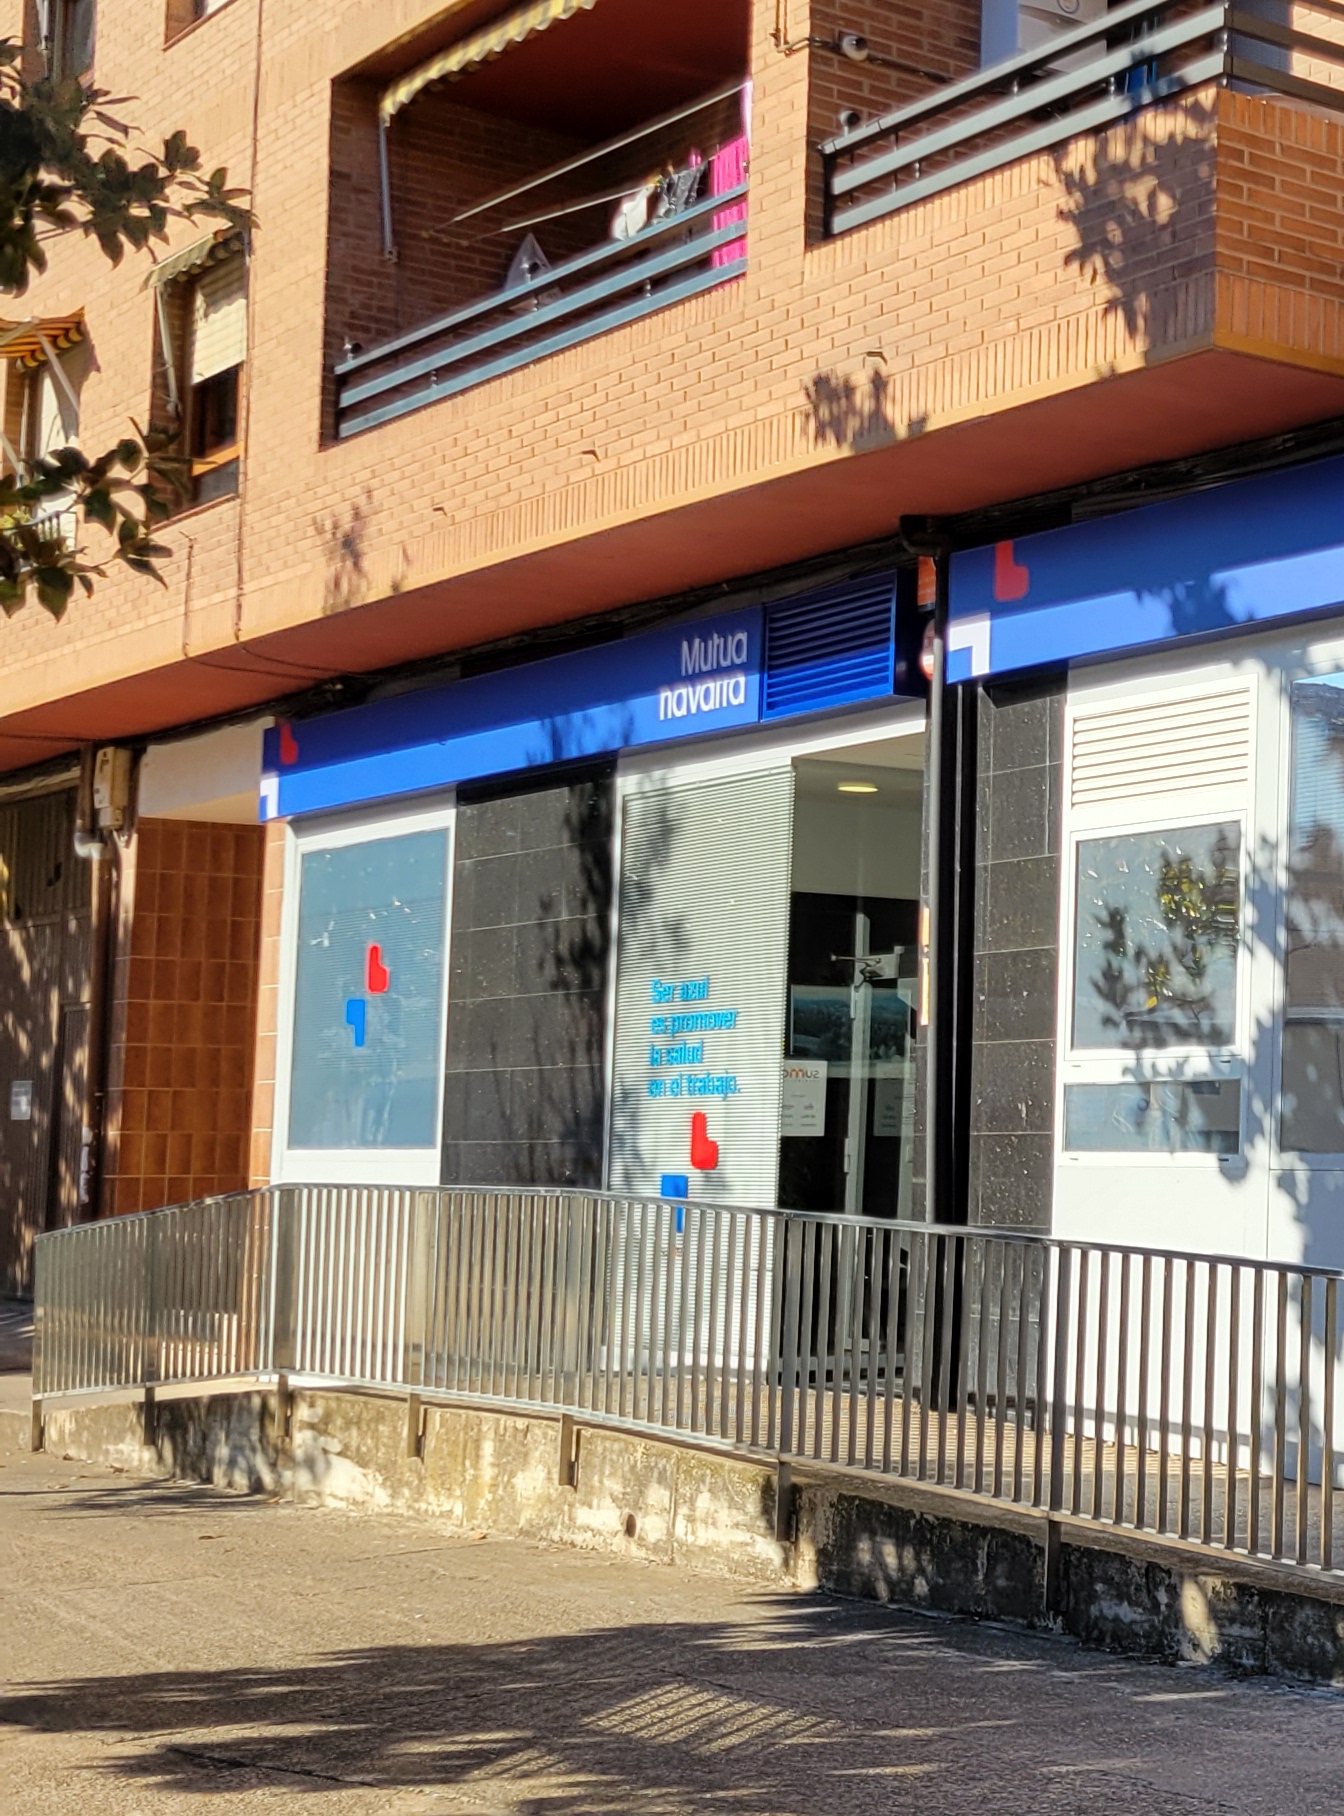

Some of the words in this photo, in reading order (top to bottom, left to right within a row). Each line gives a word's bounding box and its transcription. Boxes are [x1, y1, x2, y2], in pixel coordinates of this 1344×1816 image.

[681, 631, 748, 677] Mutua
[659, 675, 746, 721] navarra
[650, 977, 675, 1004] Ser
[679, 975, 709, 1001] azul
[650, 1016, 666, 1035] es
[669, 1008, 739, 1040] promover
[649, 1043, 661, 1067] la
[666, 1040, 704, 1066] salud
[648, 1079, 666, 1098] en
[670, 1072, 682, 1097] el
[686, 1070, 741, 1101] trabajo.
